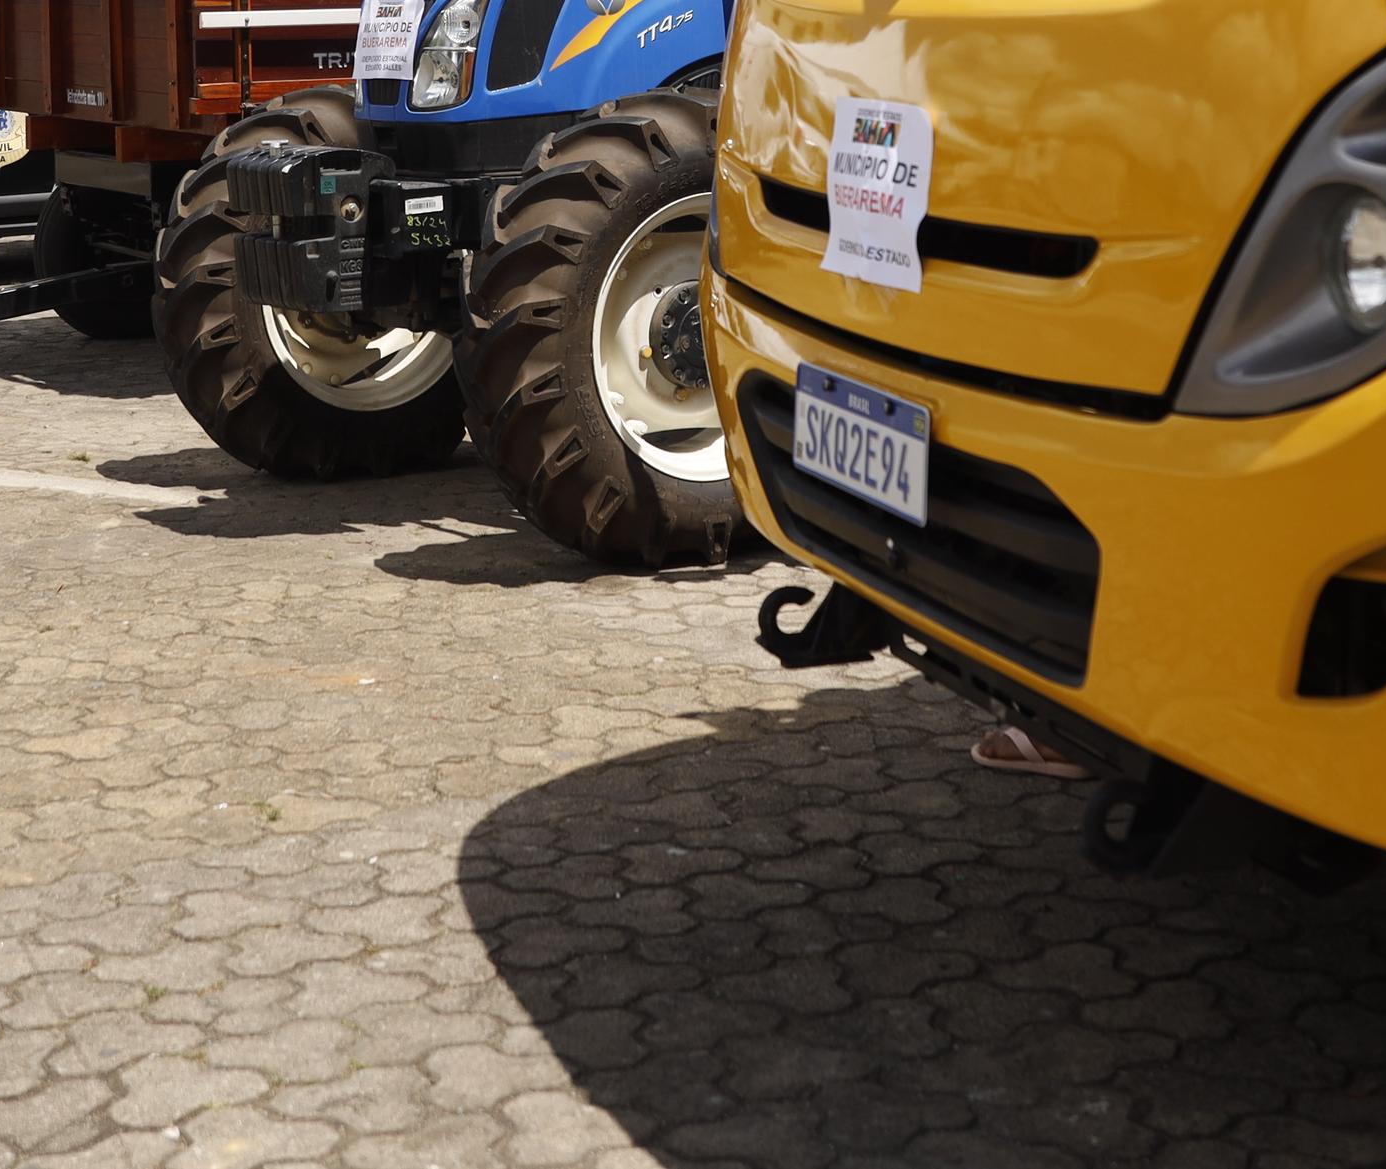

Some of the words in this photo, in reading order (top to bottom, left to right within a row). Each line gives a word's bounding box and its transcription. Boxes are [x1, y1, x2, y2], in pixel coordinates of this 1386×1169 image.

[400, 22, 413, 32] DE
[362, 37, 408, 48] BUERAREMA
[893, 162, 919, 188] DE
[805, 405, 910, 504] SKQ2E94
